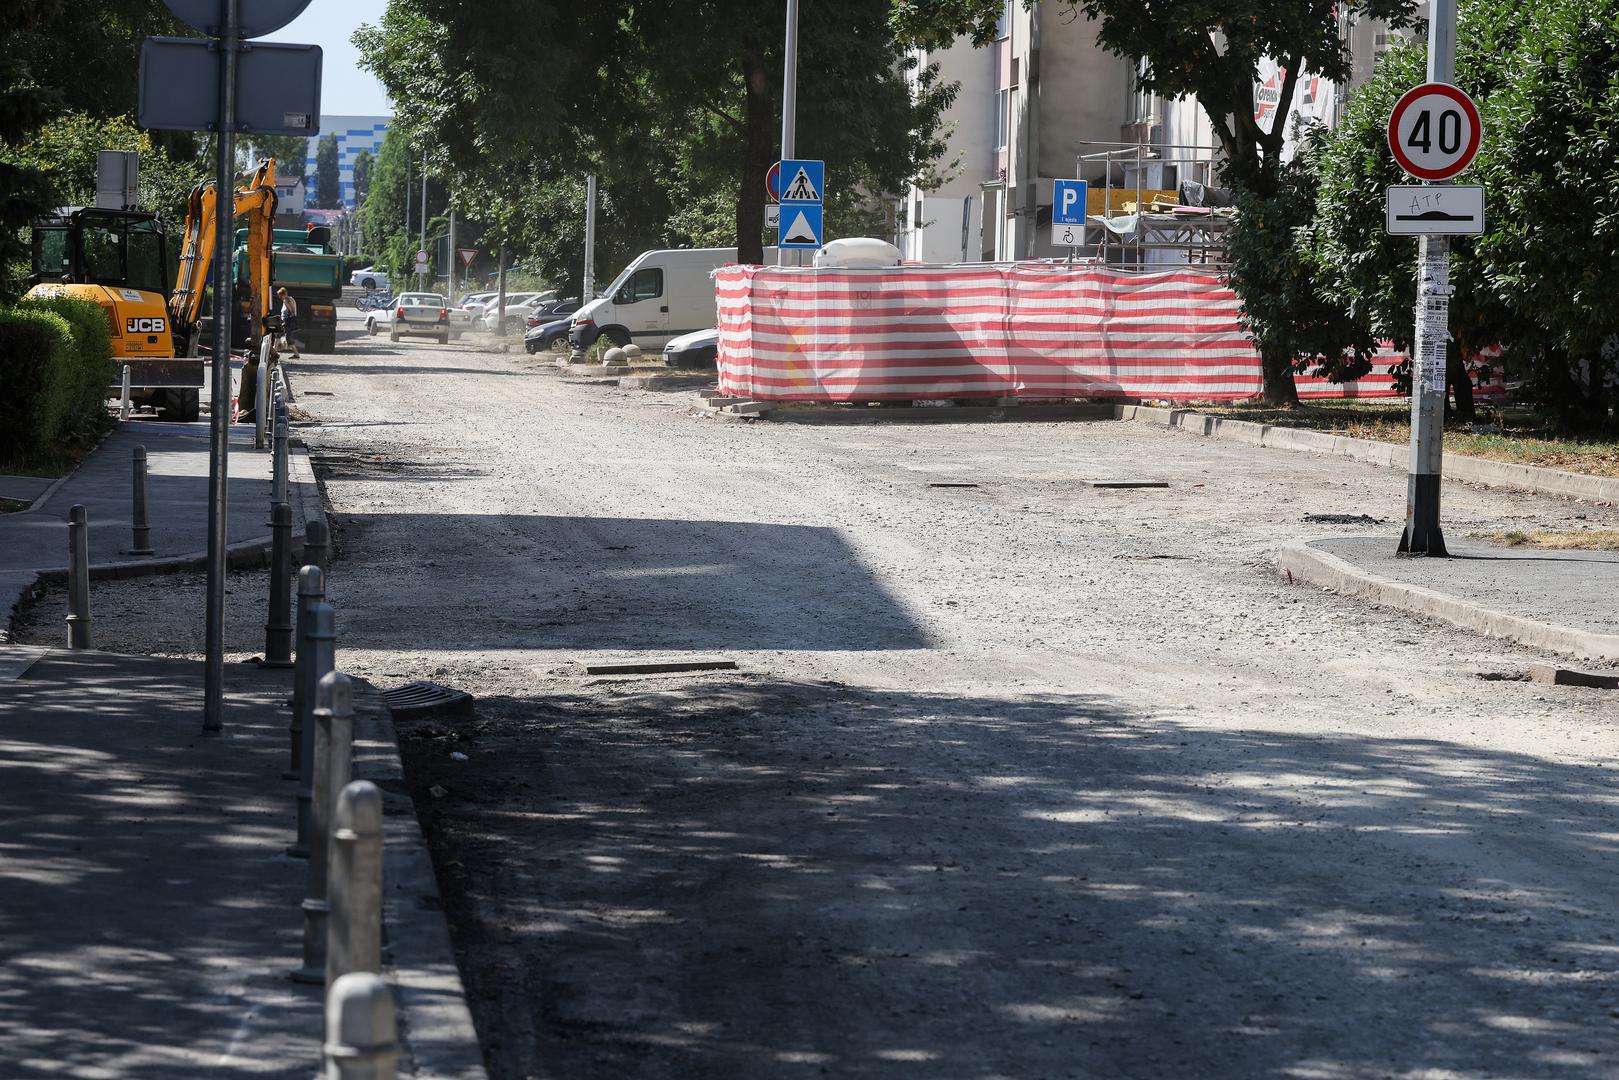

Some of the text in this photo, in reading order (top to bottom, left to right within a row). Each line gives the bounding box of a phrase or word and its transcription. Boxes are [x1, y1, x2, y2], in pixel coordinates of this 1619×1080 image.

[1407, 109, 1462, 155] 40
[1062, 188, 1077, 216] P
[1408, 192, 1443, 214] ATP
[127, 317, 166, 333] JCB
